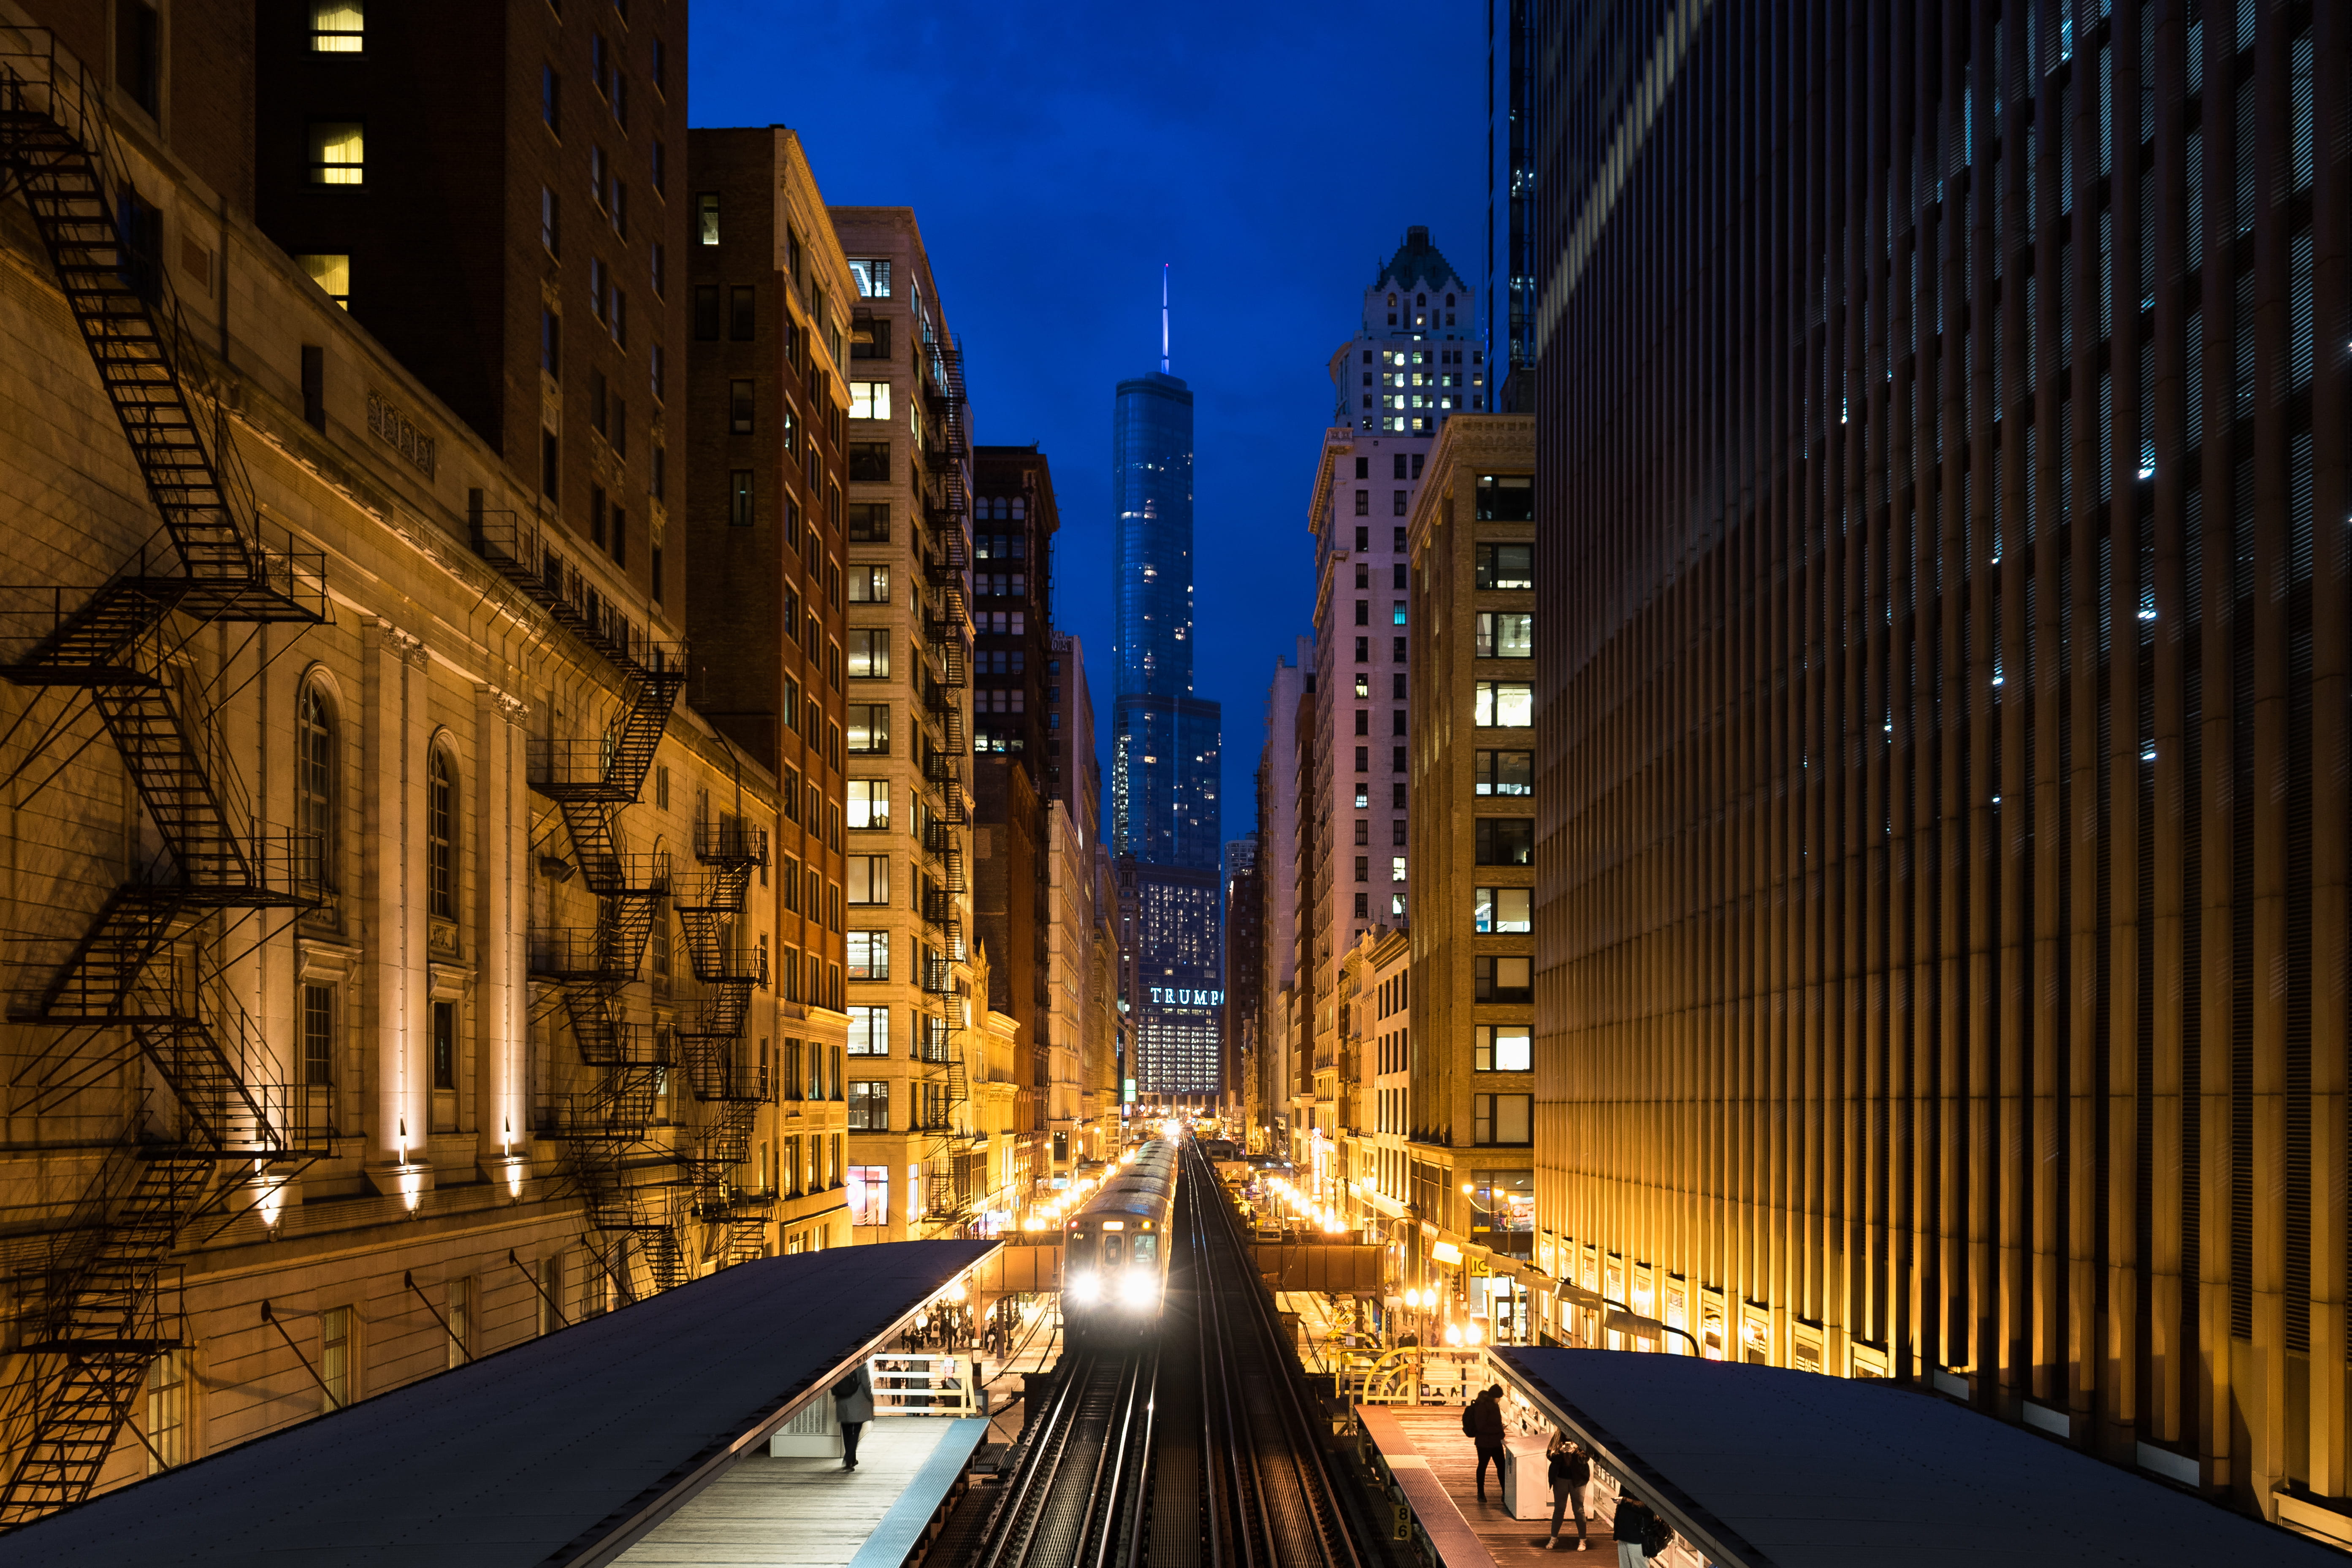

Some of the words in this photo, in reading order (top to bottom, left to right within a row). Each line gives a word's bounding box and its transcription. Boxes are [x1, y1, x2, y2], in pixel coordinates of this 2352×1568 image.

[1150, 987, 1219, 1005] TRUMP
[1805, 1358, 1812, 1373] 55
[1399, 1508, 1408, 1520] 8
[1398, 1525, 1407, 1538] 6
